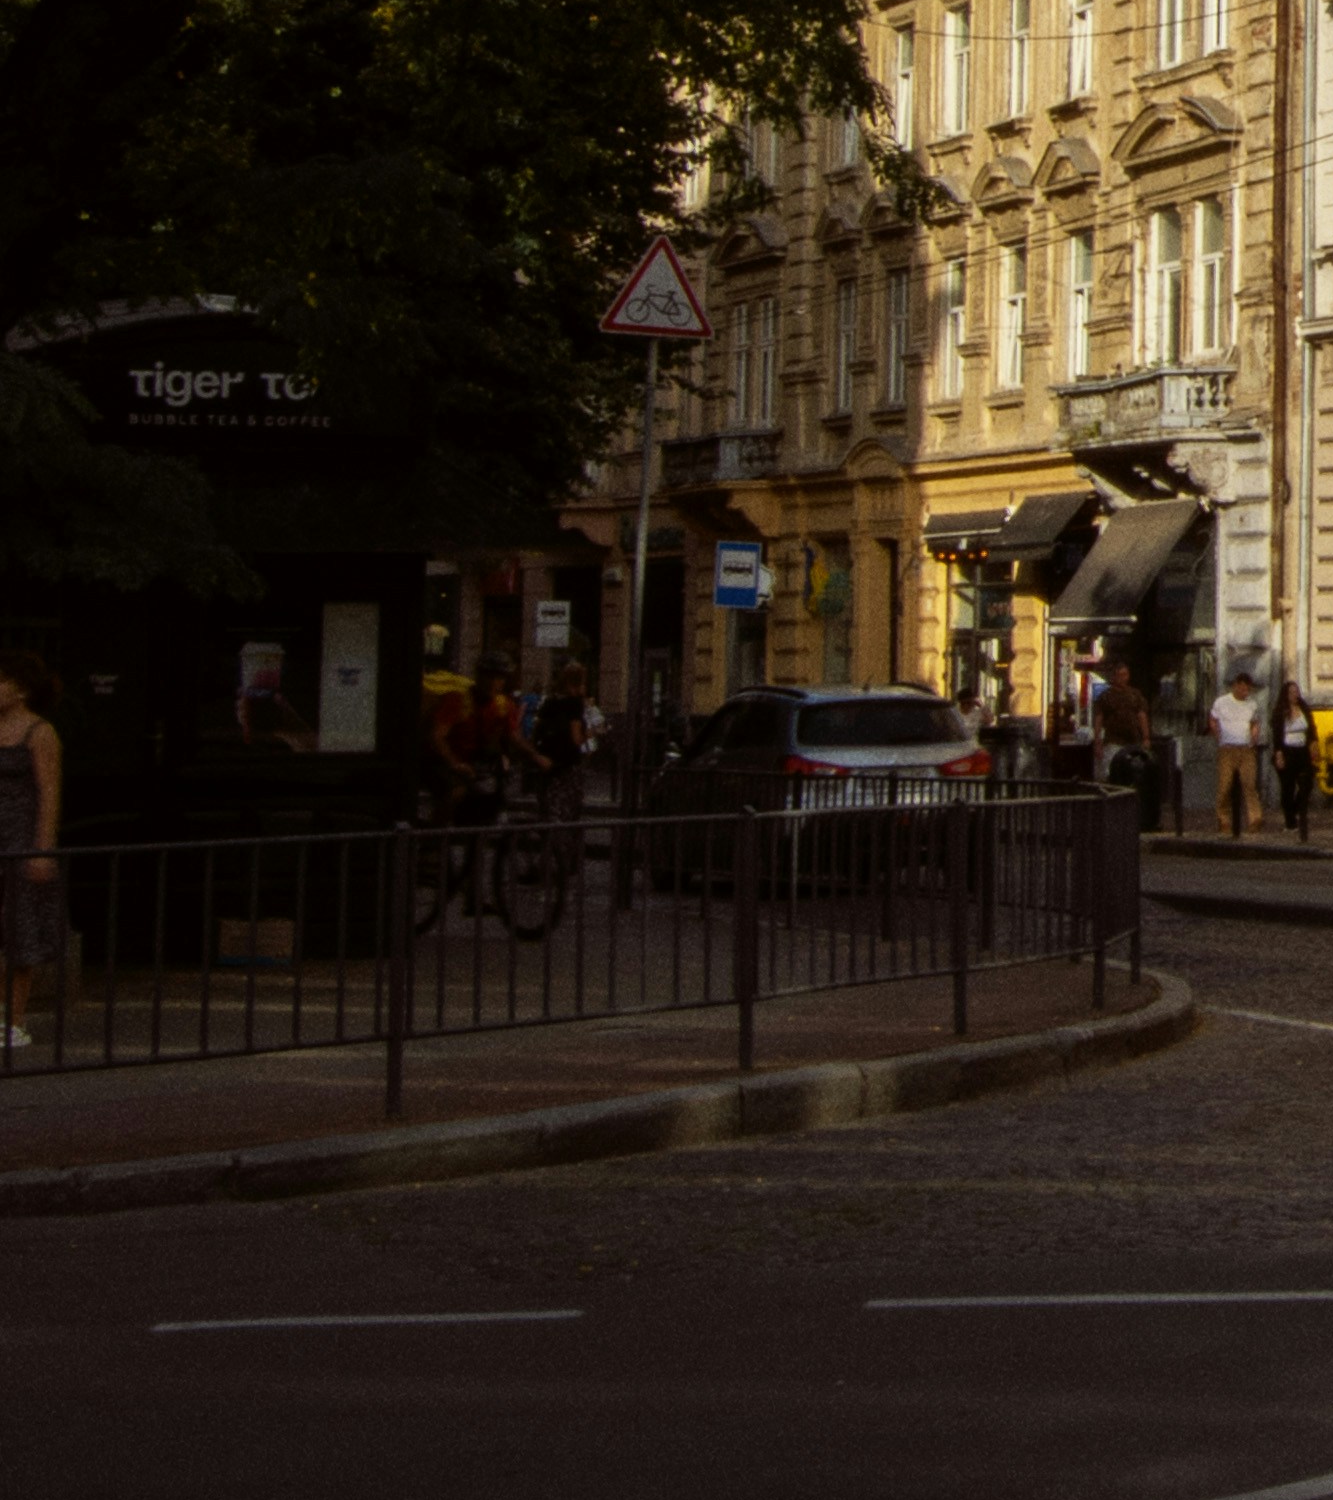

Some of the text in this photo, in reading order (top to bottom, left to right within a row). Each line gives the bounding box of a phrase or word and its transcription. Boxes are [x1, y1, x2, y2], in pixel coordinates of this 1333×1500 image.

[128, 412, 199, 426] BUBBLE
[206, 413, 239, 427] TEA
[263, 413, 332, 428] COFFEE
